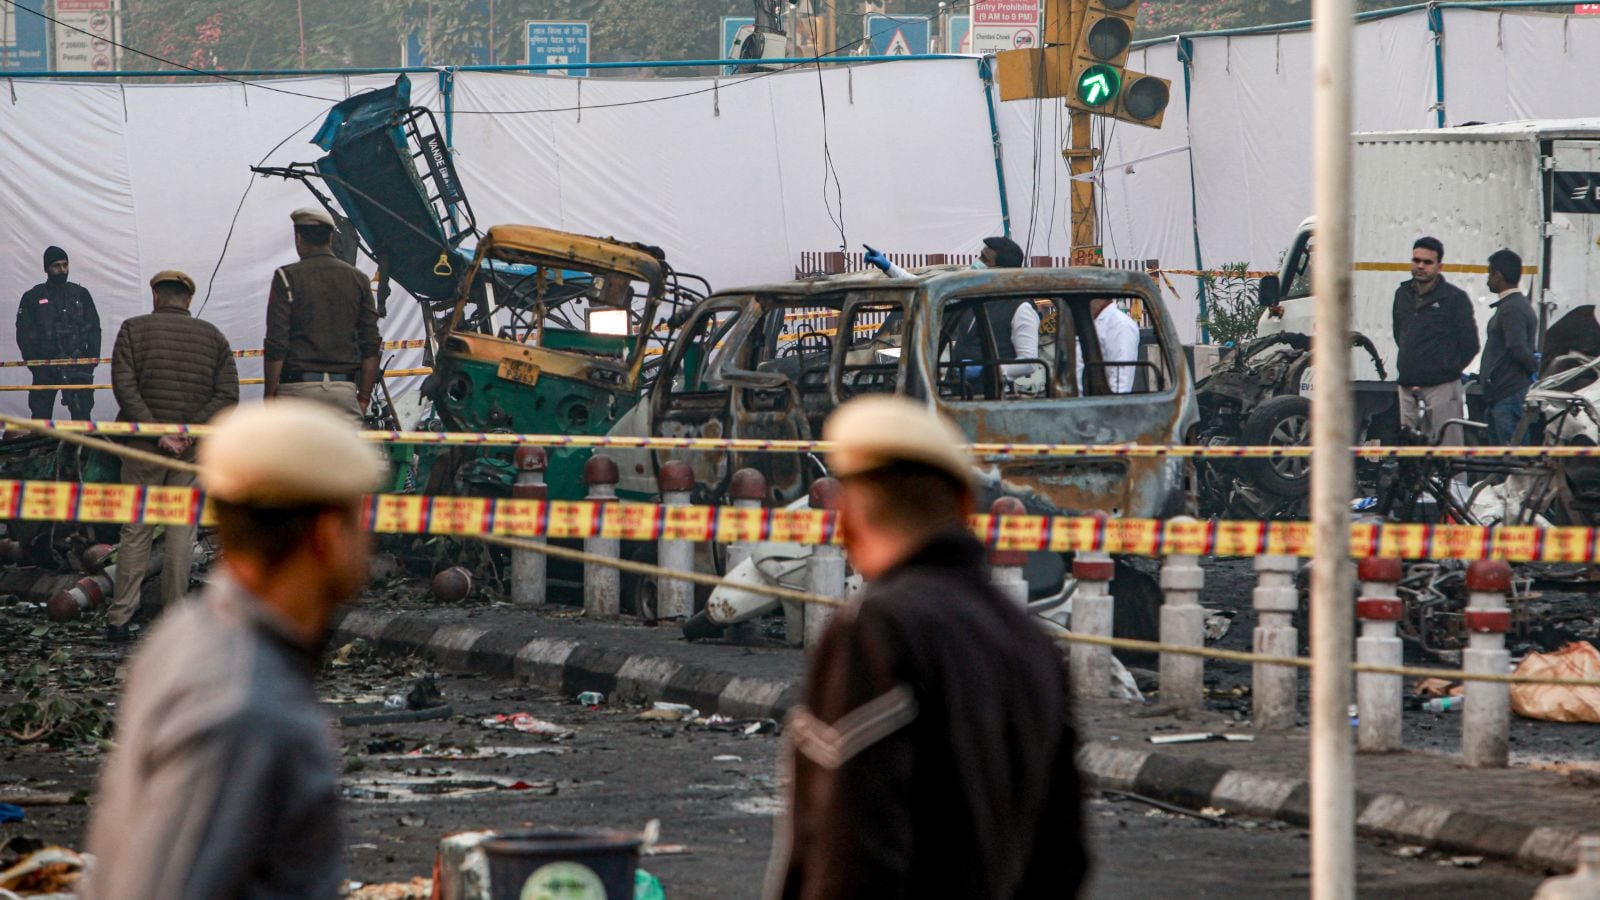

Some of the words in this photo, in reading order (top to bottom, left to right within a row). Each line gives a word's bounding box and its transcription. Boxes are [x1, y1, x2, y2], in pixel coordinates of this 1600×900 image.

[976, 3, 996, 12] Entry
[998, 3, 1036, 11] Prohibited
[979, 12, 987, 21] (9
[988, 12, 1000, 20] AM
[1018, 13, 1033, 21] PM)
[427, 138, 446, 168] VANDE
